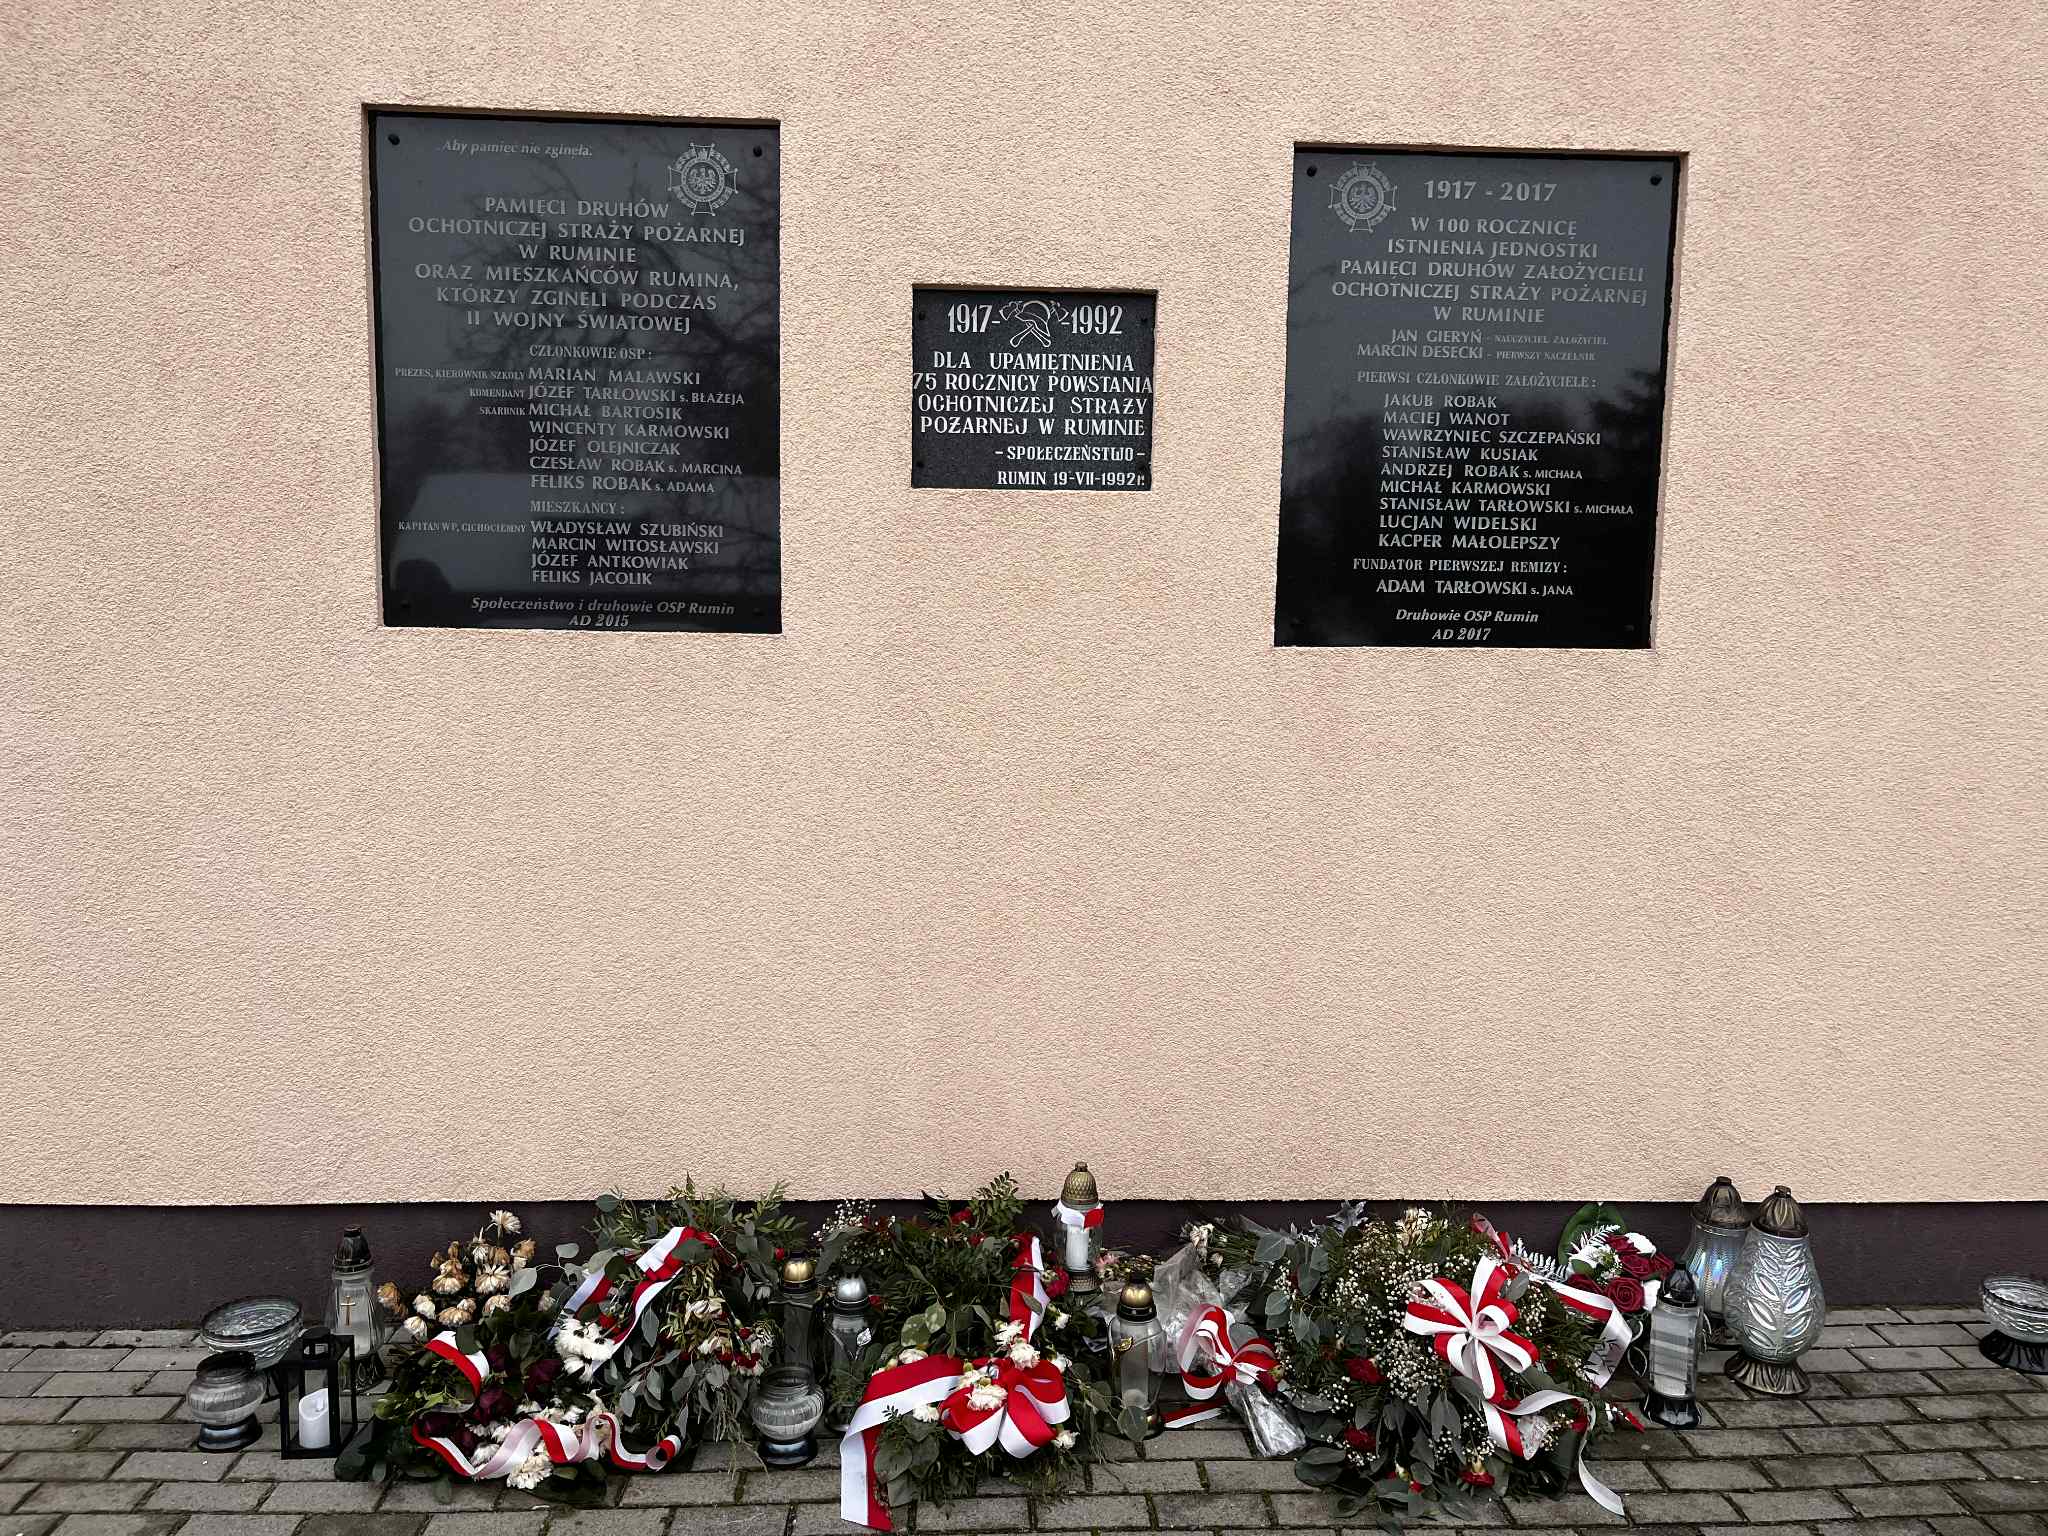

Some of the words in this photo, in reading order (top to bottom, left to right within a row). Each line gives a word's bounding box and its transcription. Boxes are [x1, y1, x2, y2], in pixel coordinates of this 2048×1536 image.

[442, 139, 467, 153] Aby
[522, 142, 540, 154] nie
[1424, 181, 1477, 199] 1917
[1501, 182, 1556, 202] 2017
[485, 197, 566, 217] PAMIĘCI
[578, 198, 668, 218] DRUHÓW
[409, 217, 547, 240] OCHOTNICZEJ
[558, 219, 633, 240] STRAŻY
[644, 222, 745, 245] POŻARNEJ
[1411, 217, 1429, 231] W
[1437, 218, 1469, 232] 100
[1477, 219, 1577, 239] ROCZNICĘ
[519, 244, 537, 259] W
[549, 246, 636, 263] RUMINIE
[1388, 239, 1484, 256] ISTNIENIA
[1491, 241, 1597, 258] JEDNOSTKI
[415, 263, 472, 279] ORAZ
[486, 265, 638, 285] MIESZKAŃCÓW
[650, 271, 739, 290] RUMINA,
[1340, 259, 1417, 281] PAMIĘCI
[1428, 259, 1514, 279] DRUHÓW
[1524, 260, 1644, 281] ZAŁOŻYCIELI
[437, 283, 519, 304] KTÓRZY
[621, 293, 716, 310] PODCZAS
[1332, 281, 1459, 302] OCHOTNICZEJ
[1470, 283, 1541, 301] STRAŻY
[1552, 284, 1647, 306] POŻARNEJ
[467, 310, 480, 325] II
[494, 311, 565, 330] WOJNY
[578, 313, 690, 334] ŚWIATOWEJ
[1433, 306, 1451, 320] W
[1461, 307, 1545, 323] RUMINIE
[1392, 329, 1418, 344] JAN
[1427, 329, 1482, 344] GIERYŃ
[529, 343, 616, 360] CZŁONKOWIE
[1358, 344, 1417, 358] MARCIN
[1422, 345, 1483, 360] DESECKI
[1496, 349, 1541, 361] PIERWSZY
[934, 351, 971, 369] DLA
[990, 353, 1134, 374] UPAMIĘTNIENIA
[528, 367, 596, 382] MARIAN
[608, 370, 700, 386] MALAWSKI
[913, 373, 937, 391] 75
[945, 373, 1040, 391] ROCZNICY
[1048, 376, 1153, 393] POWSTANIA
[1357, 371, 1411, 385] PIERWSI
[1416, 371, 1499, 388] CZŁONKOWIE
[469, 388, 525, 398] KOMENDANT
[528, 384, 575, 400] JÓZEF
[583, 386, 676, 402] TARŁOWSKI
[680, 395, 689, 403] s.
[691, 391, 744, 406] BŁAŻEJA
[1384, 394, 1433, 409] JAKUB
[1444, 396, 1497, 409] ROBAK
[480, 407, 526, 416] SKARBNIK
[528, 403, 592, 419] MICHAŁ
[602, 404, 682, 420] BARTOSIK
[918, 394, 1054, 414] OCHOTNICZEJ
[1070, 397, 1147, 415] STRAŻY
[920, 416, 1028, 435] POŻARNEJ
[1038, 418, 1055, 435] W
[1064, 418, 1145, 436] RUMINIE
[1383, 411, 1441, 427] MACIEJ
[1450, 412, 1511, 426] WANOT
[529, 421, 617, 437] WINCENTY
[624, 423, 729, 439] KARMOWSKI
[1382, 429, 1491, 444] WAWRZYNIEC
[1499, 427, 1600, 446] SZCZEPAŃSKI
[529, 436, 576, 454] JÓZEF
[587, 441, 680, 456] OLEJNICZAK
[1382, 445, 1470, 460] STANISŁAW
[1480, 447, 1538, 462] KUSIAK
[529, 456, 602, 472] CZESŁAW
[611, 458, 664, 472] ROBAK
[682, 462, 742, 476] MARCINA
[1380, 462, 1453, 479] ANDRZEJ
[1464, 464, 1520, 479] ROBAK
[1523, 471, 1532, 479] s.
[1534, 469, 1582, 480] MICHAŁA
[531, 474, 584, 490] FELIKS
[592, 475, 653, 491] ROBAK
[667, 479, 715, 494] ADAMA
[997, 471, 1046, 485] RUMIN
[1380, 480, 1442, 494] MICHAŁ
[1451, 482, 1551, 496] KARMOWSKI
[1380, 497, 1470, 511] STANISŁAW
[1479, 498, 1571, 513] TARŁOWSKI
[1574, 506, 1582, 514] s.
[1585, 503, 1633, 515] MICHAŁA
[399, 521, 439, 531] KAPITAN
[531, 520, 631, 535] WŁADYSŁAW
[639, 520, 724, 538] SZUBIŃSKI
[1380, 515, 1444, 530] LUCJAN
[1453, 515, 1537, 531] WIDELSKI
[531, 538, 596, 552] MARCIN
[605, 539, 719, 554] WITOSŁAWSKI
[1378, 533, 1442, 548] KACPER
[1452, 535, 1560, 550] MAŁOLEPSZY
[531, 553, 579, 570] JÓZEF
[588, 555, 689, 570] ANTKOWIAK
[1354, 557, 1422, 571] FUNDATOR
[1429, 559, 1505, 574] PIERWSZEJ
[1511, 560, 1567, 574] REMIZY:
[532, 570, 581, 584] FELIKS
[589, 571, 652, 587] JACOLIK
[1377, 579, 1425, 594] ADAM
[1435, 580, 1527, 595] TARŁOWSKI
[1531, 587, 1539, 595] s.
[1542, 584, 1574, 597] JANA
[578, 599, 583, 610] i
[587, 599, 653, 613] druhowie
[657, 601, 685, 613] OSP
[689, 601, 735, 615] Rumin
[1396, 609, 1460, 623] Druhowie
[1464, 610, 1492, 623] OSP
[1494, 610, 1538, 623] Rumin
[569, 614, 592, 626] AD
[597, 614, 629, 627] 2015
[1433, 627, 1457, 640] AD
[1459, 627, 1491, 641] 2017
